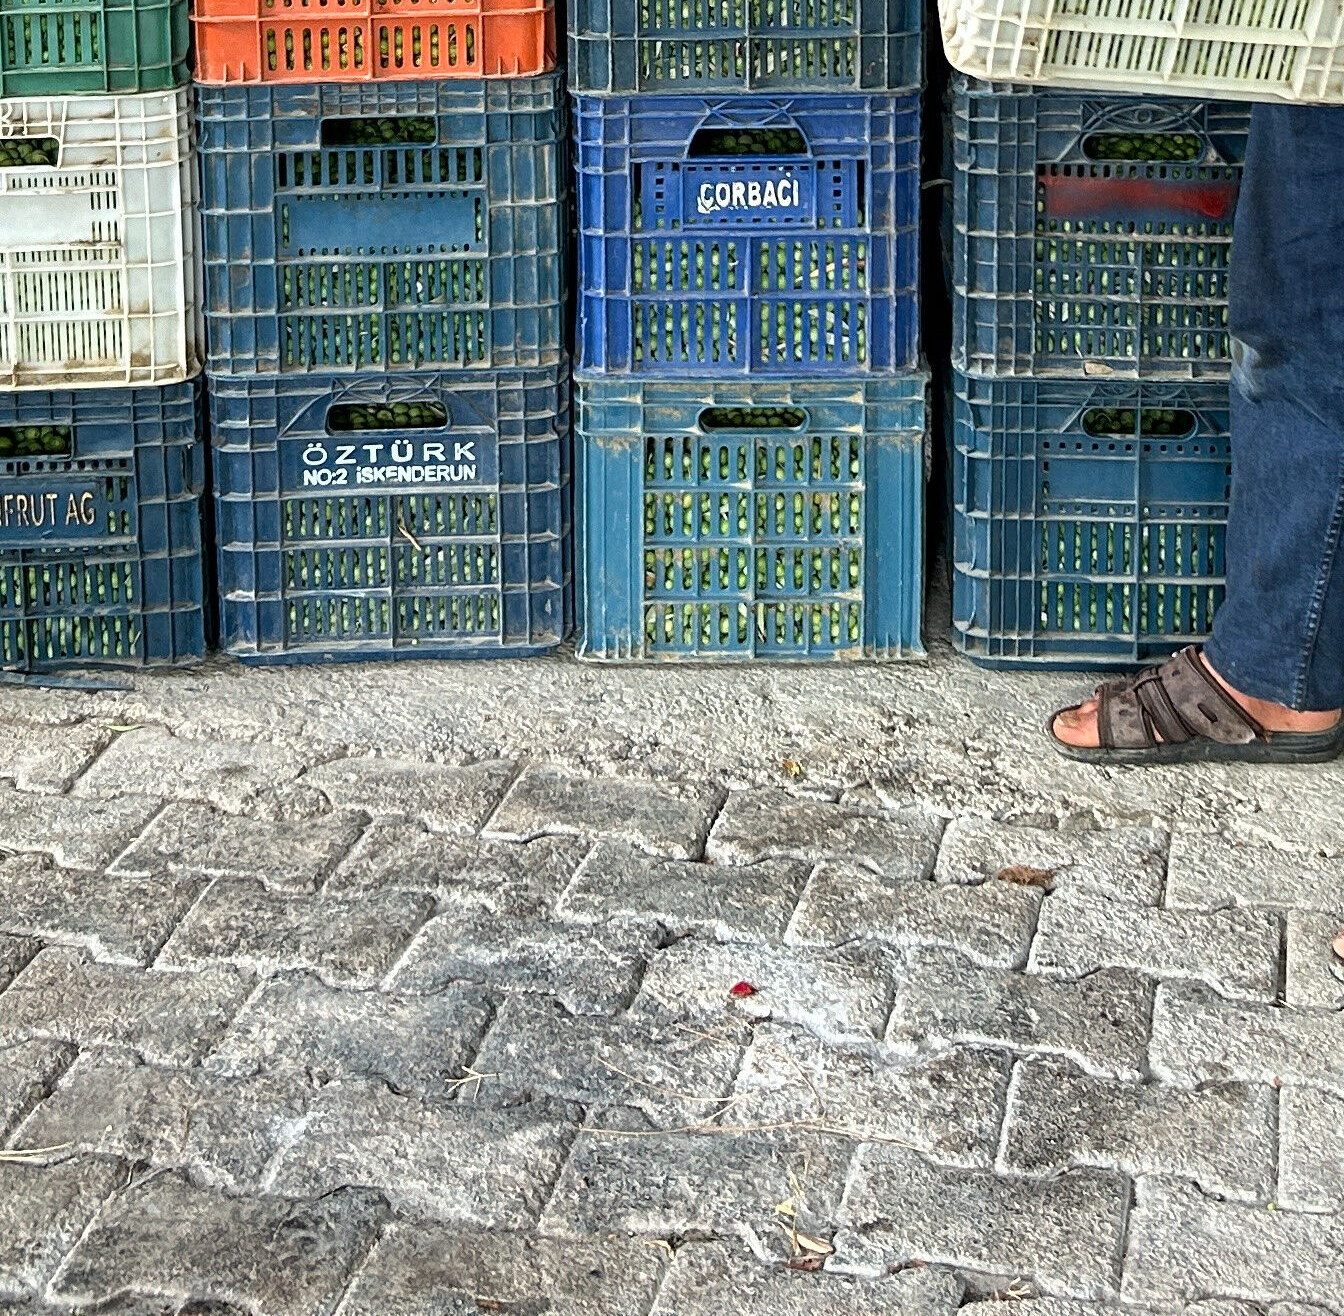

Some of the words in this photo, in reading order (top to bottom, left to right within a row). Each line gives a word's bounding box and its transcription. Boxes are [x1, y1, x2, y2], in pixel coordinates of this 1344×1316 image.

[302, 439, 476, 466] ÖZTÜRK
[303, 468, 348, 486] NO:2
[65, 491, 95, 526] AG
